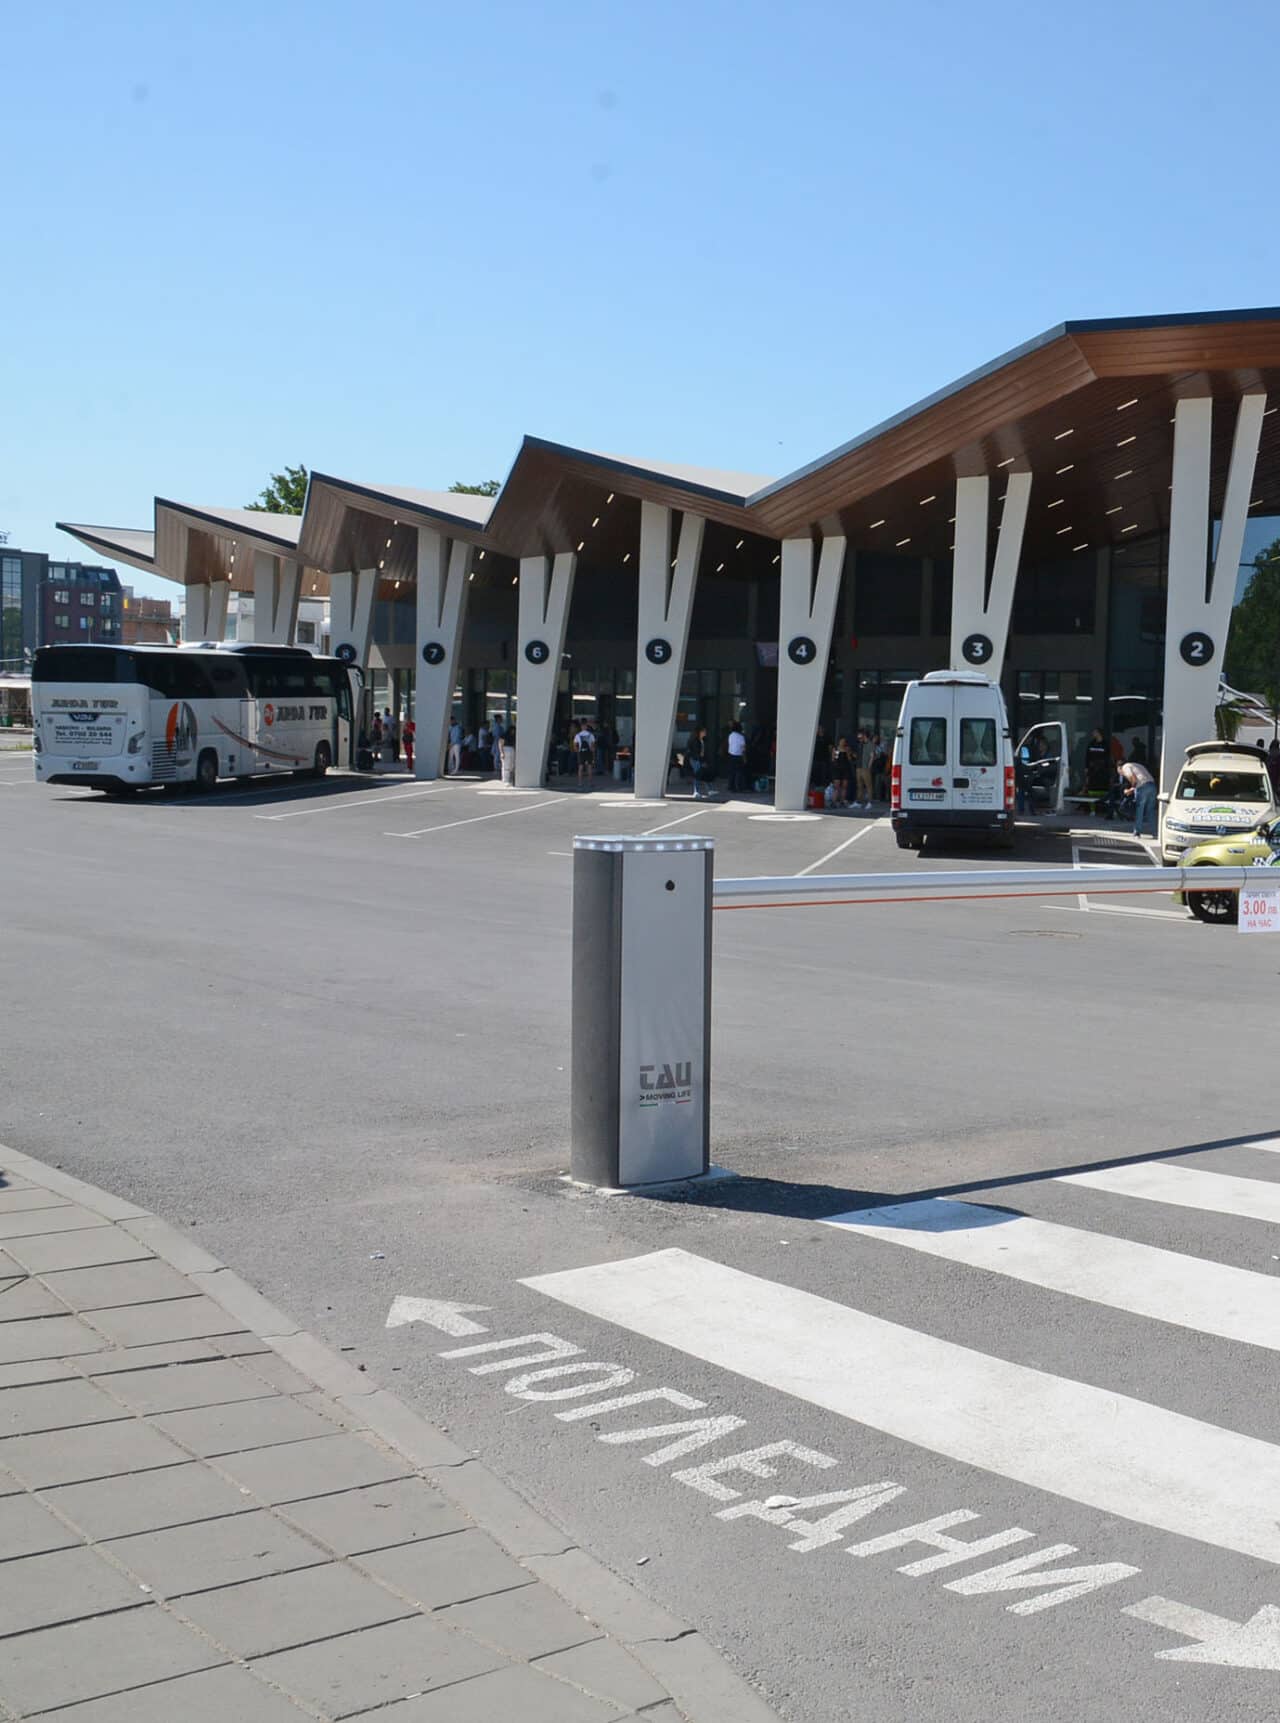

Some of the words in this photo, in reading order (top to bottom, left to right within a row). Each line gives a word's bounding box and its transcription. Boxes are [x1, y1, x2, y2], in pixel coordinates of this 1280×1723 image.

[342, 649, 351, 659] 8
[430, 648, 438, 659] 7
[532, 647, 542, 658] 6
[653, 646, 663, 658] 5
[796, 644, 808, 658] 4
[972, 642, 983, 657] 3
[1190, 641, 1203, 657] 2
[276, 705, 305, 722] ARDA
[308, 704, 328, 721] TUR
[1243, 900, 1267, 916] 3.00
[639, 1061, 691, 1090] TAU
[437, 1331, 1142, 1617] ПОГЛЕДНИ
